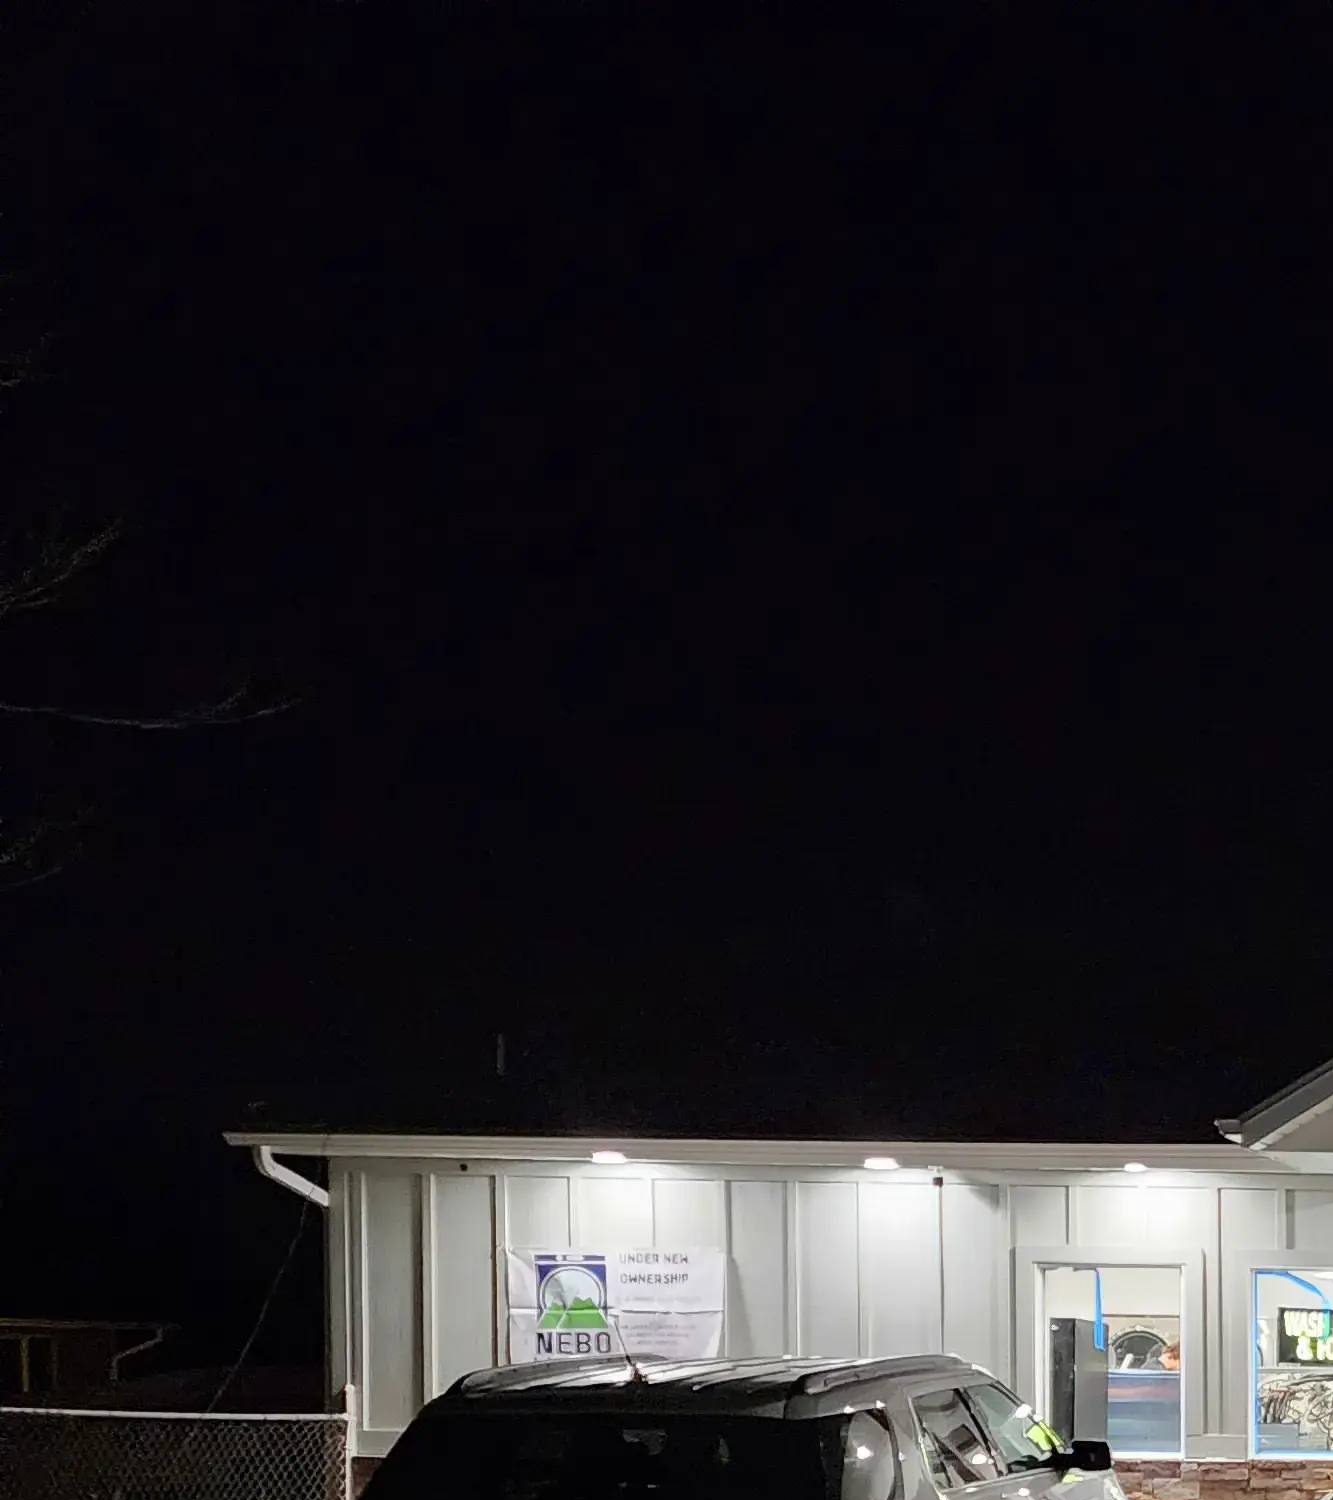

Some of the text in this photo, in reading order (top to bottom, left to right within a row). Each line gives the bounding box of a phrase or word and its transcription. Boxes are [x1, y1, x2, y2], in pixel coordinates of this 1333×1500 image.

[619, 1252, 688, 1264] UNDER NEW
[620, 1273, 688, 1285] OWNERSHIP
[1284, 1311, 1330, 1337] WASH
[536, 1332, 611, 1354] NEBO
[1296, 1336, 1313, 1360] &
